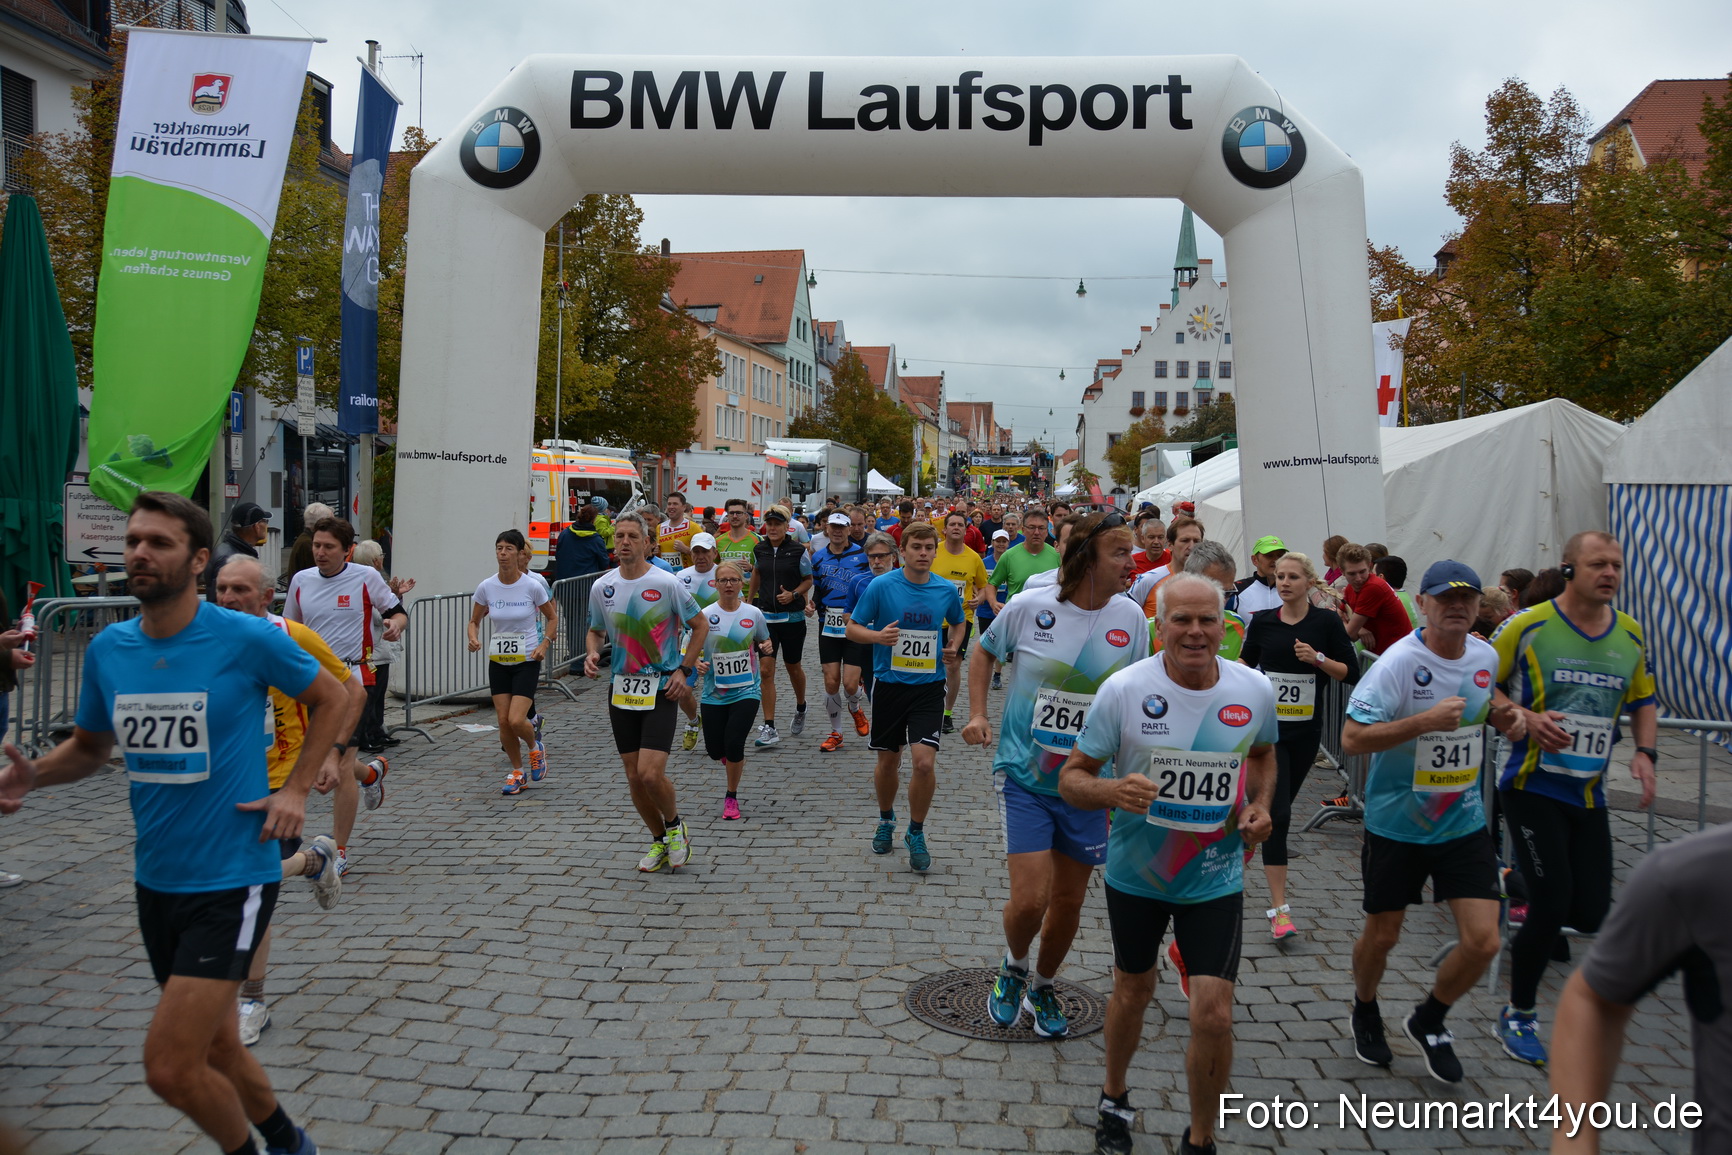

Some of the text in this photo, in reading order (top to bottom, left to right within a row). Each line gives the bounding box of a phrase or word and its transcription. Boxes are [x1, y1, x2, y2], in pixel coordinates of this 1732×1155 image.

[569, 70, 1193, 146] BMW Laufsport
[471, 109, 533, 136] BMW
[301, 346, 310, 370] P
[234, 398, 241, 428] P
[398, 450, 507, 464] www.bmw-laufsport.de
[1263, 453, 1379, 469] www.bmw-laufsport.de
[69, 492, 105, 501] Fußgäng
[77, 512, 110, 522] Kreuzung
[91, 523, 114, 531] Untere
[903, 612, 932, 624] RUN
[1034, 631, 1055, 639] PARTL
[496, 640, 518, 654] 125
[902, 640, 930, 657] 204
[717, 659, 749, 675] 3102
[622, 678, 651, 695] 373
[1553, 669, 1625, 690] BOCK
[624, 696, 645, 705] Harald
[1039, 692, 1092, 707] PARTL Neumark
[1278, 685, 1301, 703] 29
[116, 702, 189, 711] PARTL Neumarkt
[1222, 710, 1249, 721] Hervis
[123, 715, 199, 749] 2276
[1141, 722, 1170, 730] PARTL
[1419, 732, 1474, 742] PARTL Neumarkt
[1431, 742, 1471, 768] 341
[137, 757, 187, 771] Bernhard
[1153, 757, 1227, 768] PARTL Neumarkt
[1158, 769, 1232, 802] 2048
[1429, 773, 1471, 784] Karlheinz
